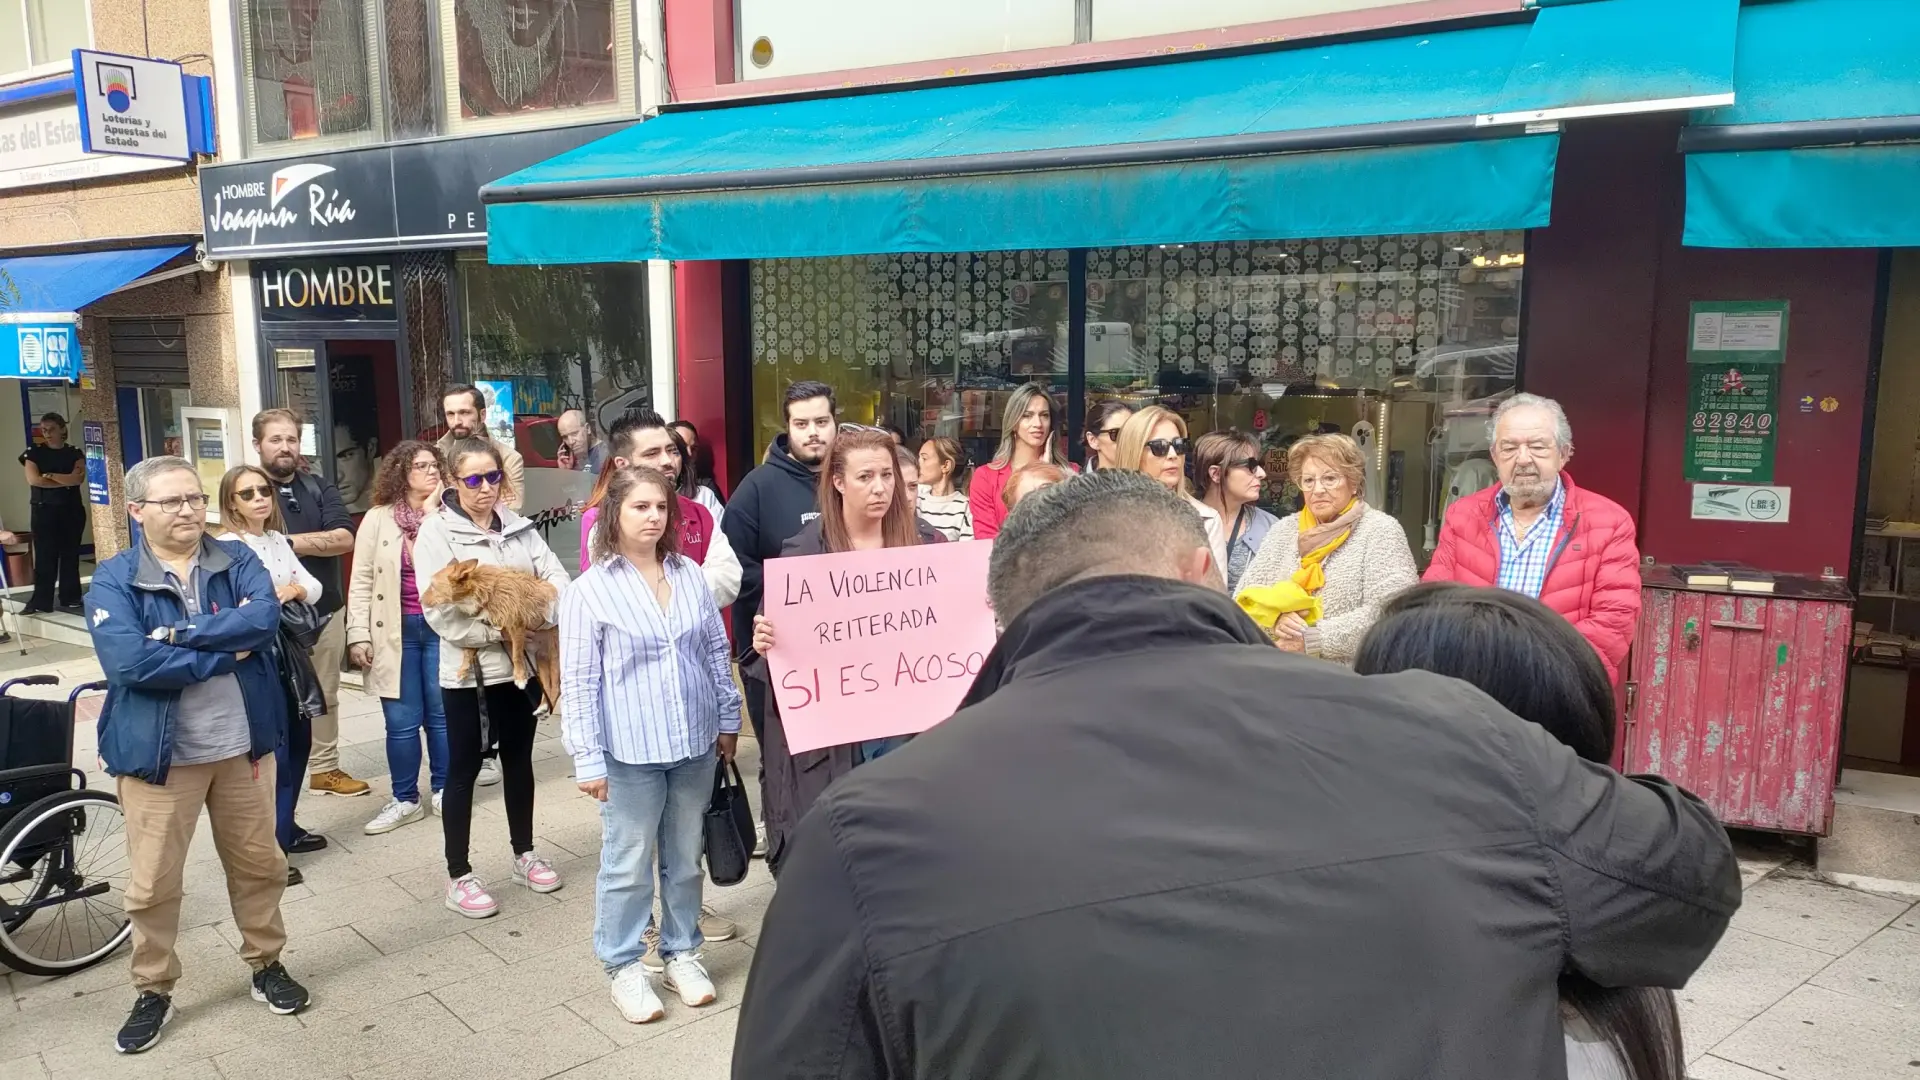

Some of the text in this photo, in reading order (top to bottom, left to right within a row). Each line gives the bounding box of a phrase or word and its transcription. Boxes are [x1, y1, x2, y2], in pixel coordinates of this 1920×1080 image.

[0, 133, 16, 153] as
[20, 121, 41, 151] del
[104, 124, 167, 139] Apuestas del
[145, 119, 151, 128] y
[105, 136, 139, 147] Estado
[222, 181, 266, 200] HOMBRE
[308, 183, 356, 227] Rúa
[262, 264, 394, 308] HOMBRE
[1692, 411, 1772, 429] 82340
[784, 565, 938, 606] LA VIOLENCIA
[814, 606, 938, 645] REITERADA
[782, 651, 984, 710] SI ES ACOSO
